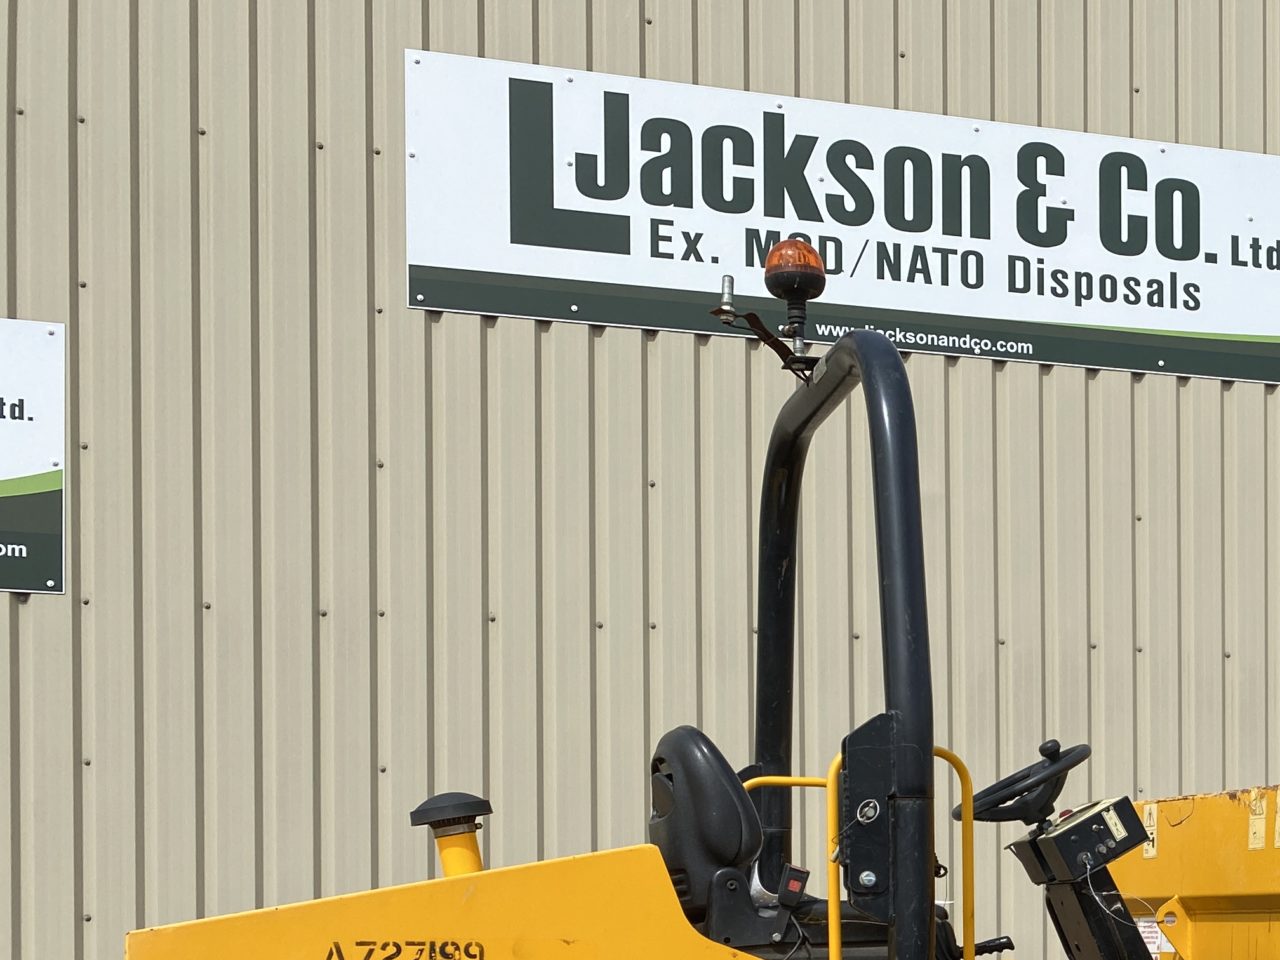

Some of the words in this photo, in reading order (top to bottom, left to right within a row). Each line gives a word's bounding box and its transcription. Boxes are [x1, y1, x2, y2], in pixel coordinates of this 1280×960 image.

[1016, 141, 1075, 248] &
[1099, 151, 1218, 264] Co.
[650, 217, 719, 264] Ex.
[744, 227, 985, 290] MD/NATO
[1008, 254, 1201, 312] Disposals
